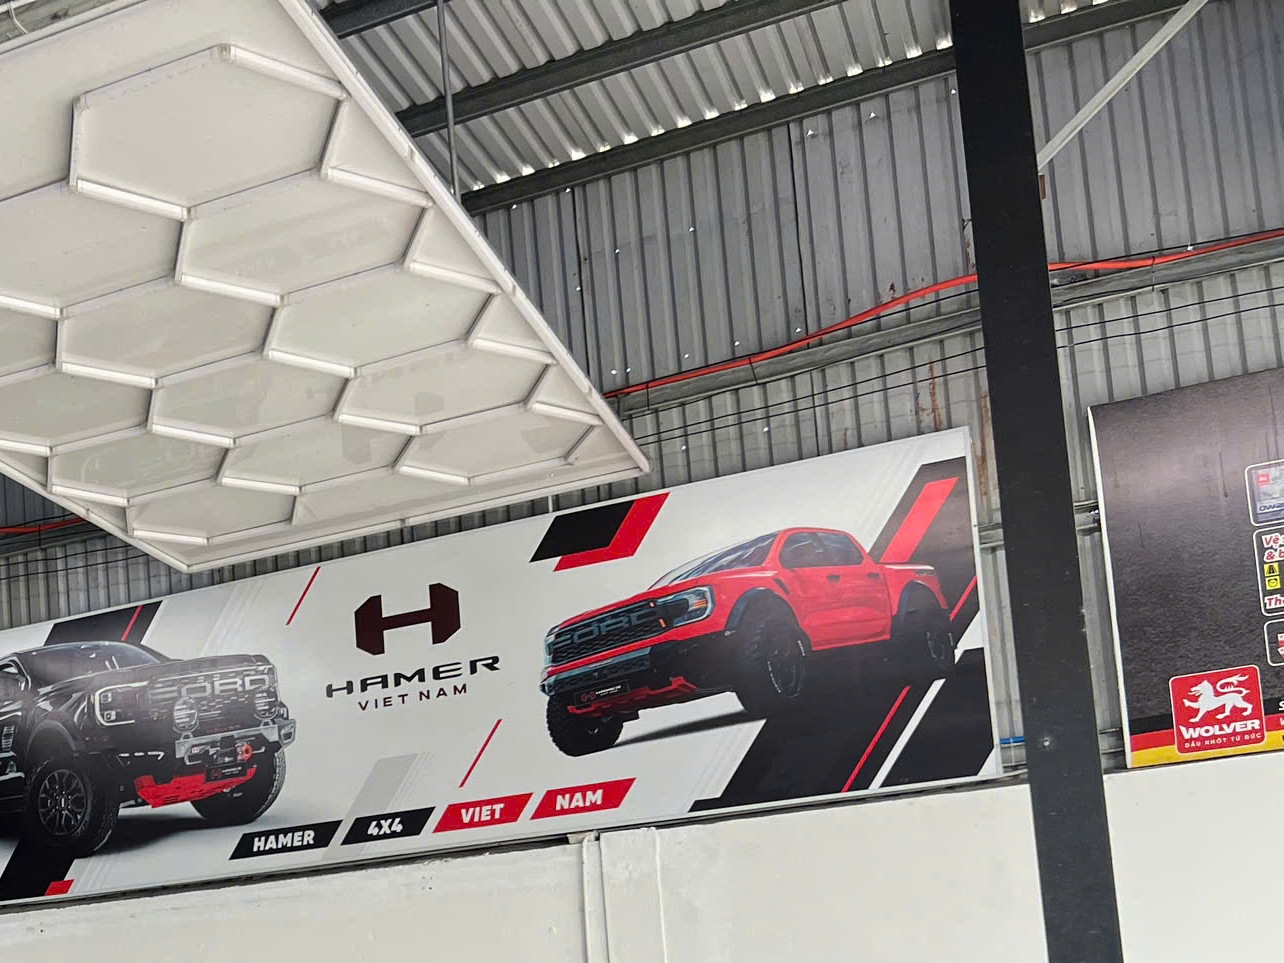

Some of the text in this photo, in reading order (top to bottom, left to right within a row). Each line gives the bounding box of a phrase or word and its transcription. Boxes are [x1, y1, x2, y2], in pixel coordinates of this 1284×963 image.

[325, 655, 501, 698] HAMER
[358, 683, 467, 711] VIET NAM
[1179, 719, 1261, 740] WOLVER
[555, 789, 604, 811] NAM
[460, 803, 504, 824] VIET
[366, 817, 403, 836] 4X4
[252, 830, 315, 853] HAMER
